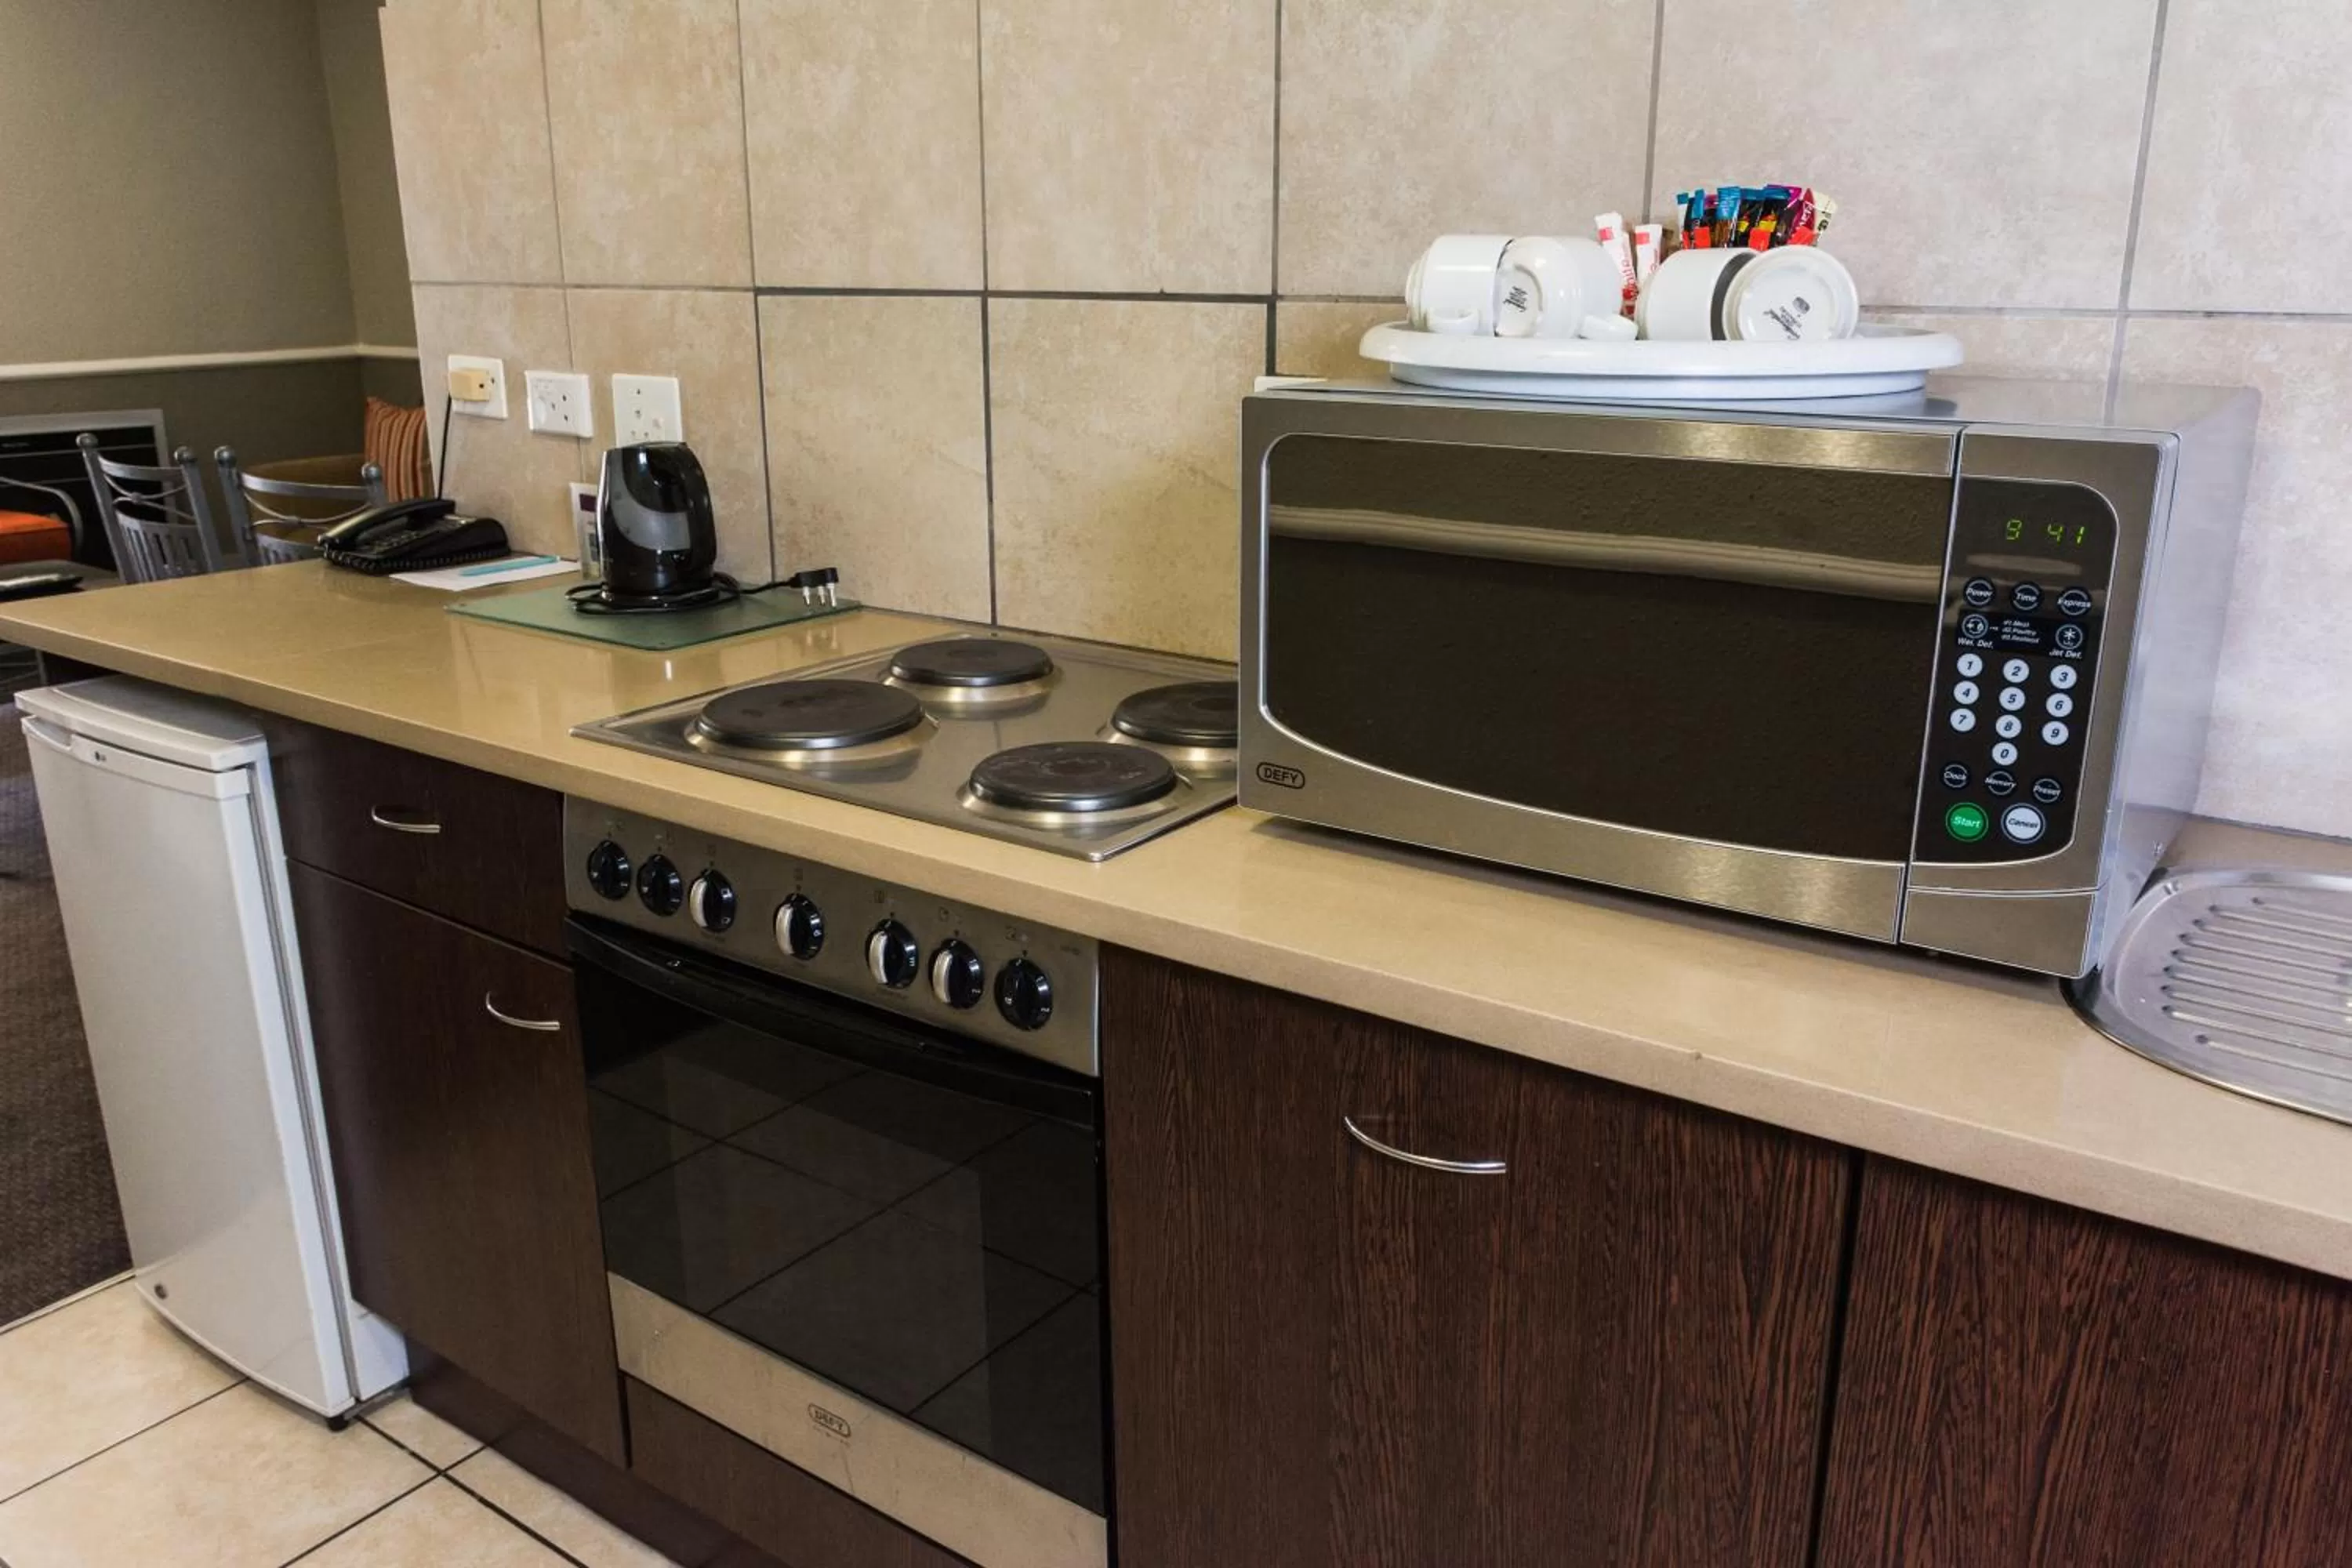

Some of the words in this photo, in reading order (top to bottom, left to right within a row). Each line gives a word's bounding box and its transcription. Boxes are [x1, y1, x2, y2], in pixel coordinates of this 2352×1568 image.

[2005, 519, 2023, 540] 9
[2047, 524, 2085, 544] 41
[1965, 588, 1994, 597] Power
[2016, 593, 2038, 602] Time
[2057, 597, 2092, 608] Express
[1966, 660, 1973, 670] 1
[2011, 666, 2021, 677] 2
[2058, 671, 2069, 682] 3
[1962, 688, 1972, 698] 4
[2008, 694, 2017, 704] 5
[2054, 700, 2064, 710] 6
[1958, 714, 1967, 725] 7
[2003, 720, 2013, 731] 8
[2050, 728, 2060, 739] 9
[2000, 749, 2009, 759] 0
[1264, 767, 1299, 784] DEFY
[1944, 771, 1966, 781] Clock
[1984, 777, 2016, 787] Memory
[2033, 786, 2061, 797] Preset
[1952, 815, 1980, 829] Start
[2008, 818, 2038, 829] Cancel
